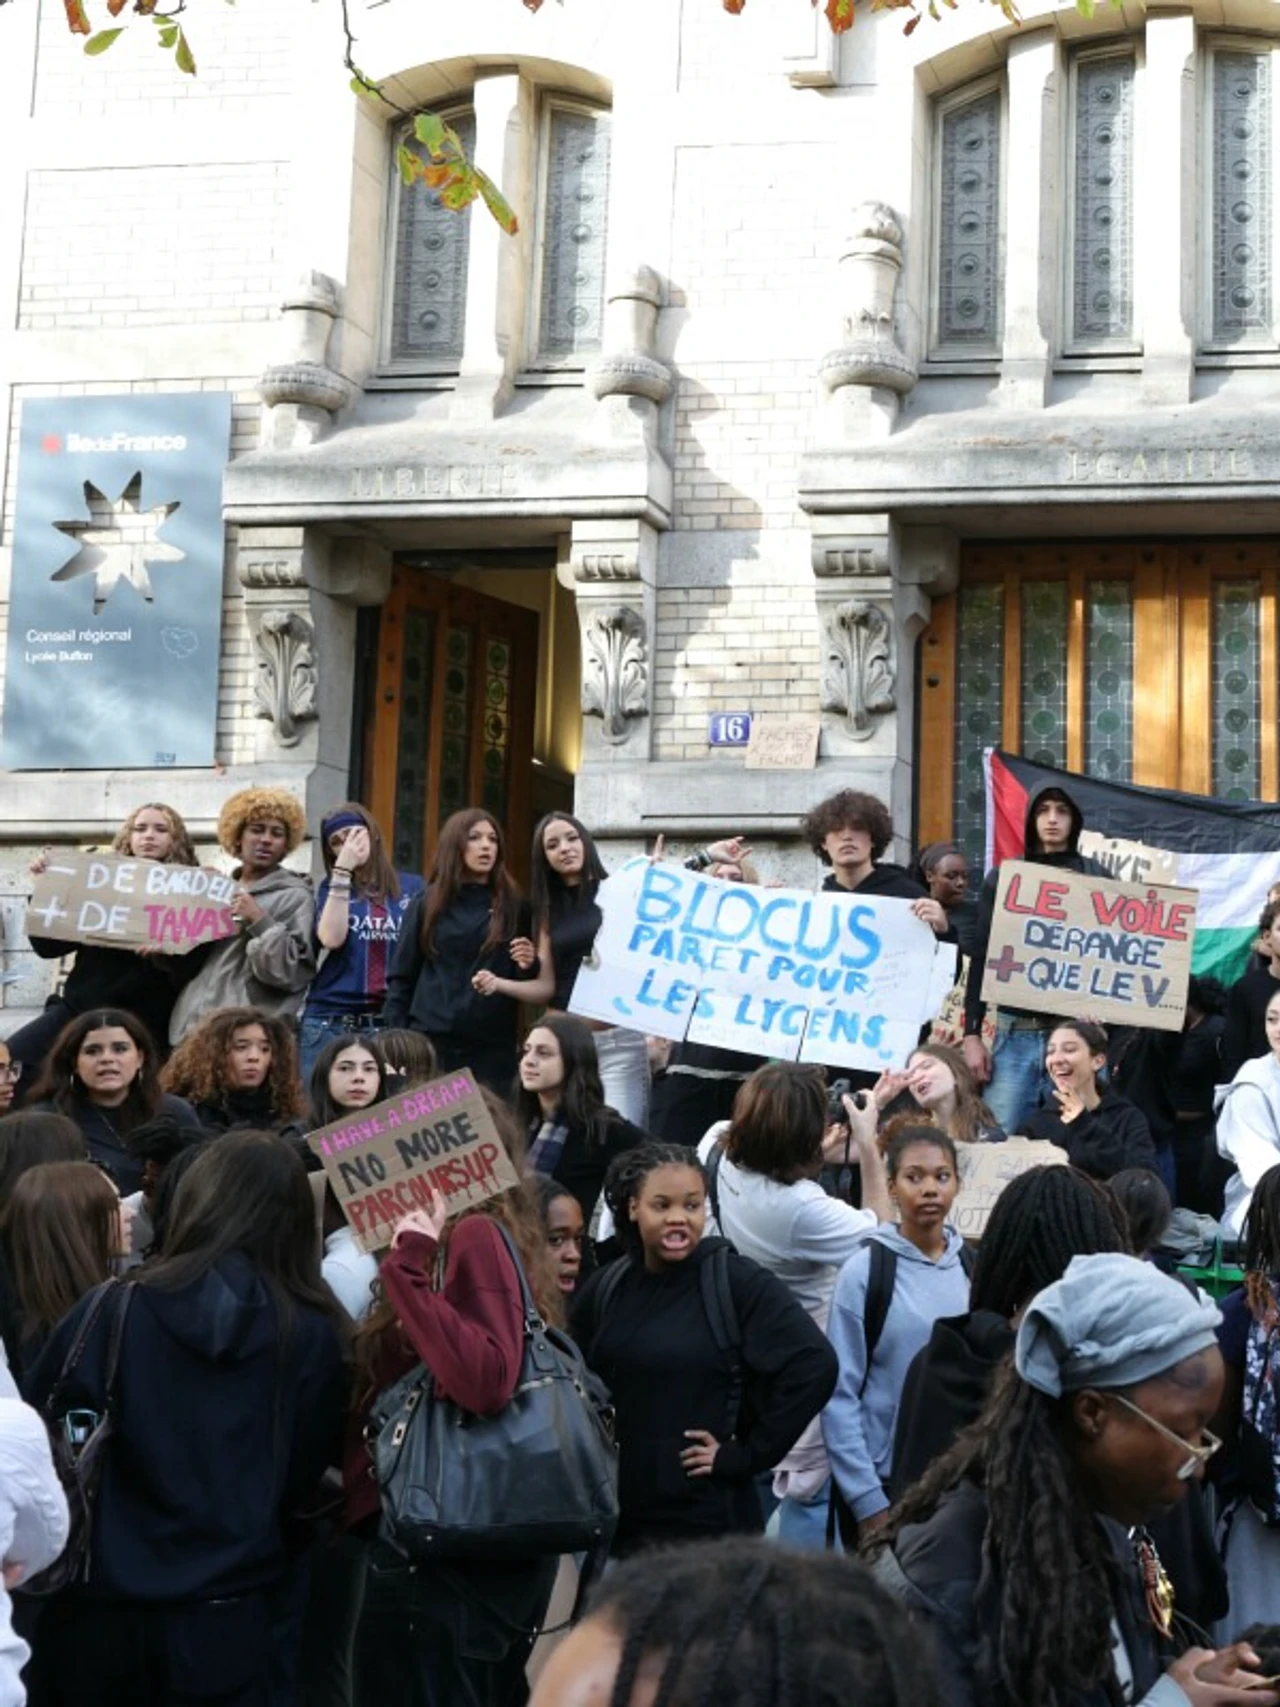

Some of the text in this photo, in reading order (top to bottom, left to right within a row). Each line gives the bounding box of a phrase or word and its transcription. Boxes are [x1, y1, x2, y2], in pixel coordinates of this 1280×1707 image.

[26, 629, 77, 643] Conseil
[717, 716, 744, 741] 16
[87, 864, 138, 893] DE
[1003, 873, 1070, 921] LE
[77, 901, 131, 934] DE
[635, 867, 882, 970] BLOCUS
[628, 923, 710, 973] PAR
[711, 945, 760, 974] ET
[767, 955, 870, 994] POUR
[1028, 957, 1082, 991] QUE
[1090, 967, 1134, 1001] LE
[636, 968, 715, 1019] LES
[333, 1117, 386, 1152] HAVE
[387, 1108, 402, 1129] A
[404, 1076, 473, 1122] DREAM
[338, 1112, 480, 1196] NO MORE
[346, 1143, 499, 1236] PARCOURSUP
